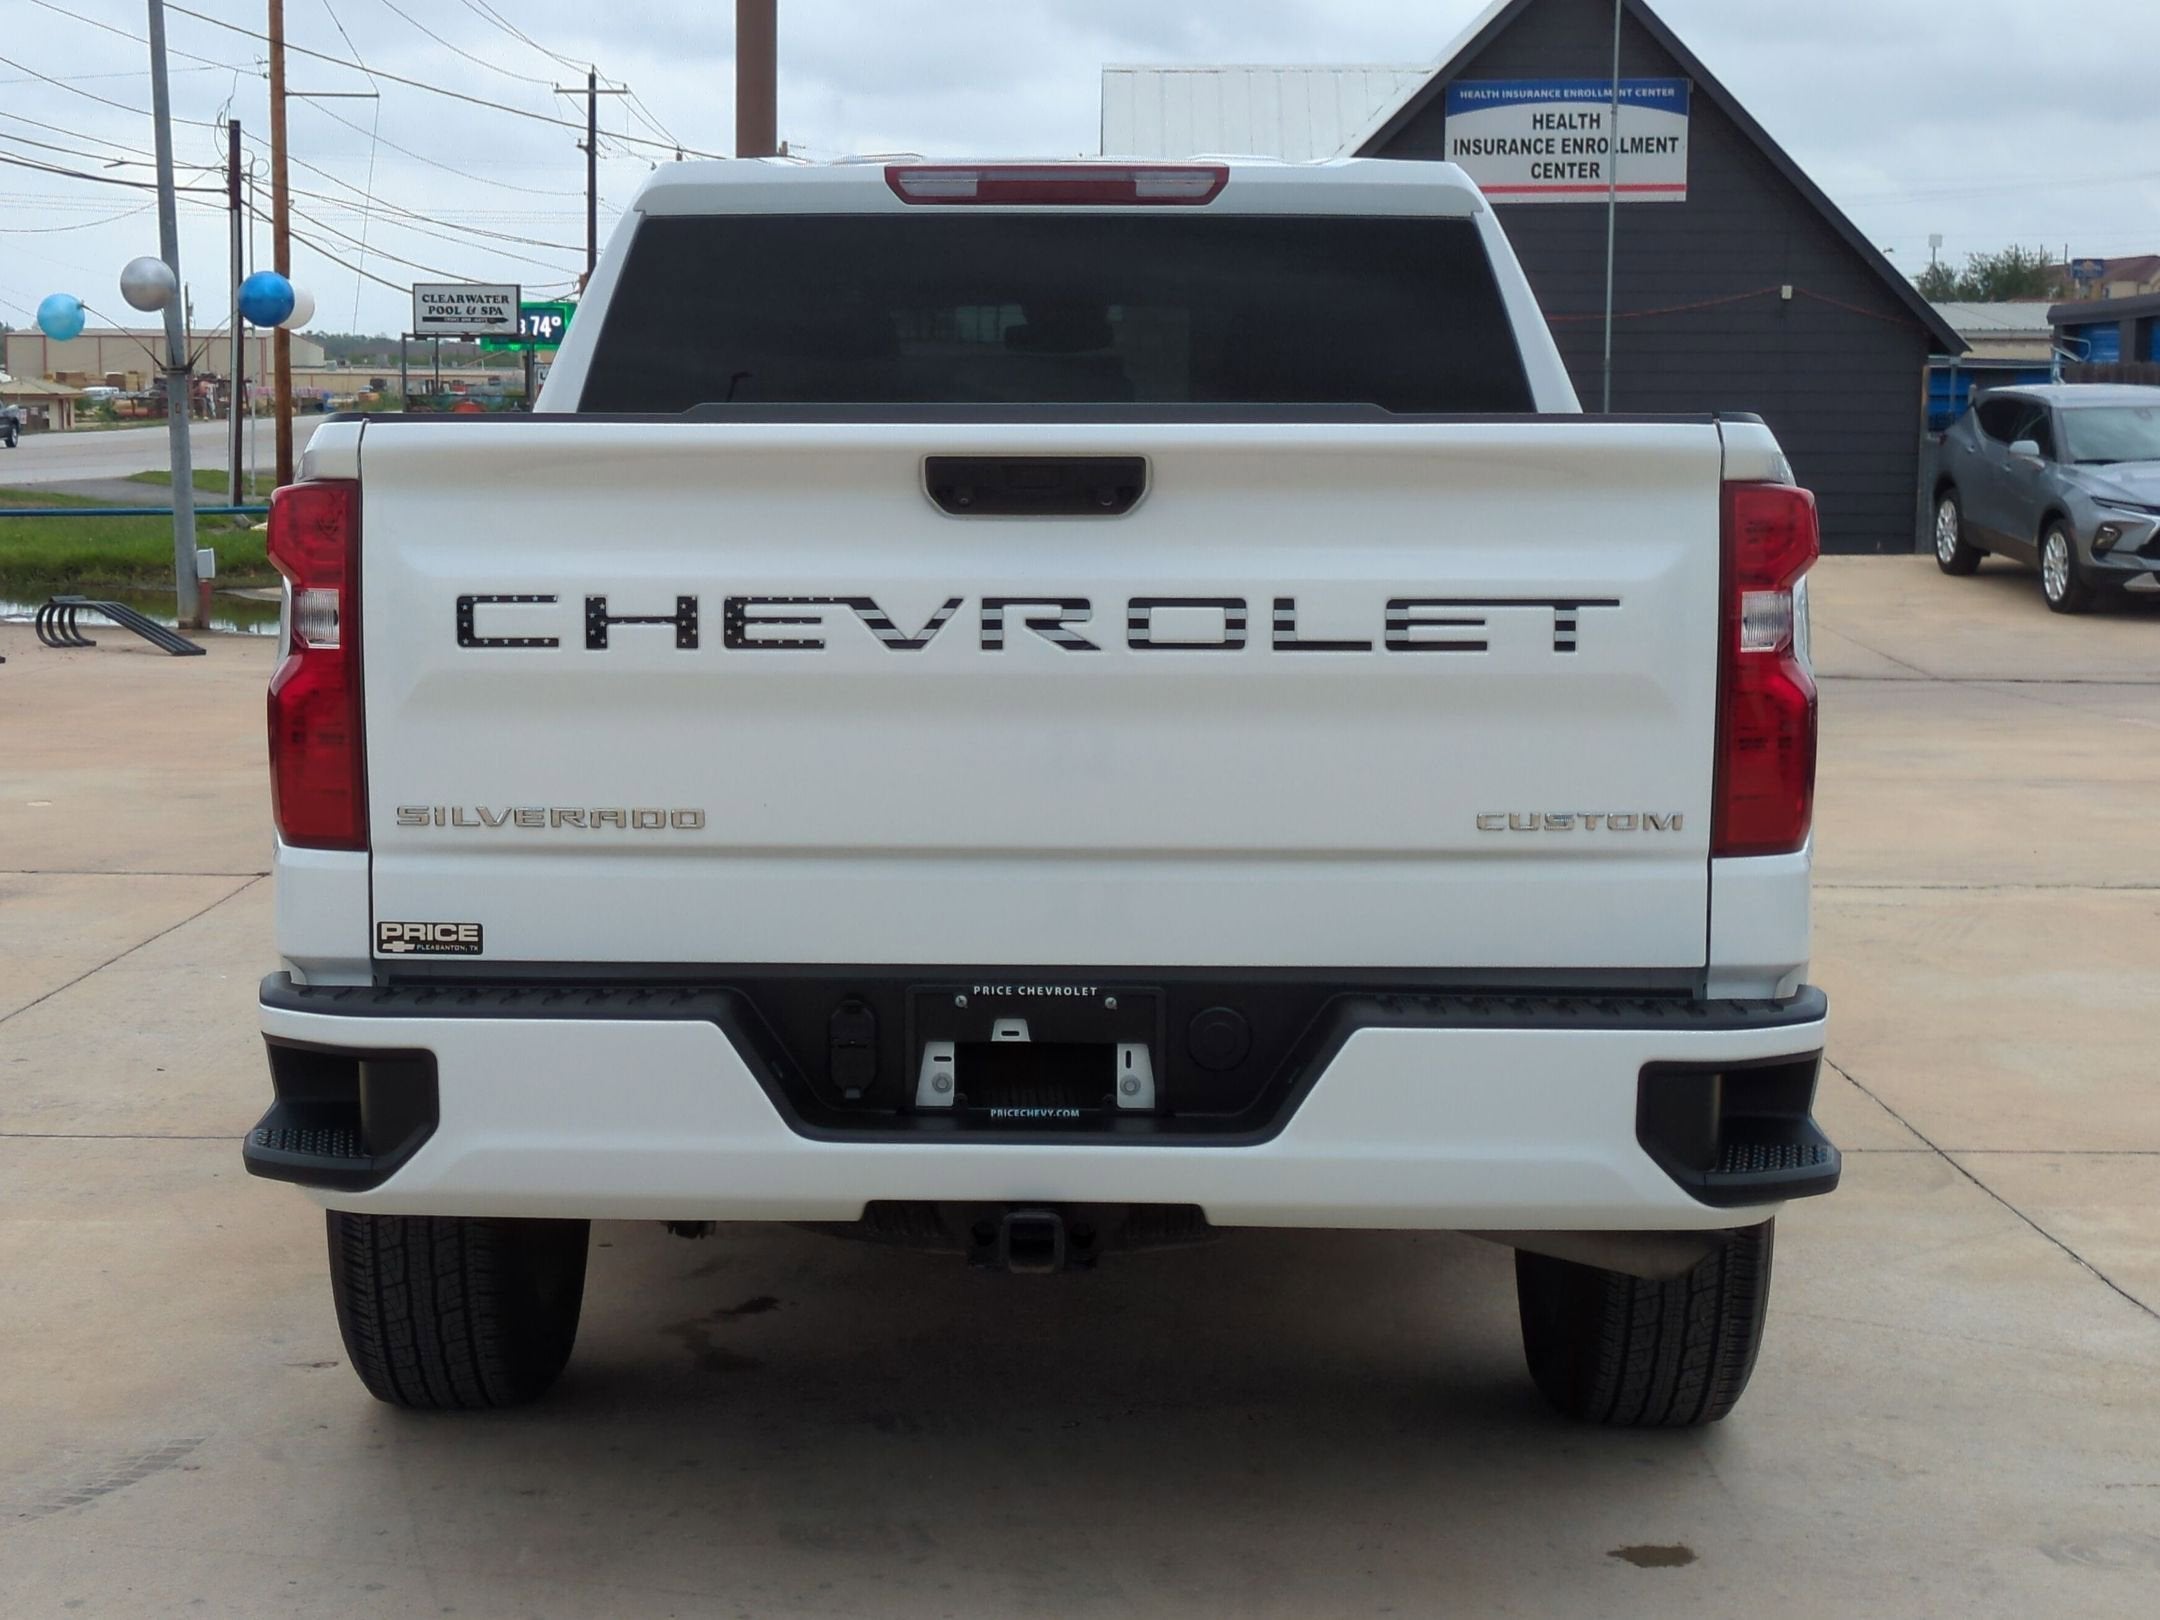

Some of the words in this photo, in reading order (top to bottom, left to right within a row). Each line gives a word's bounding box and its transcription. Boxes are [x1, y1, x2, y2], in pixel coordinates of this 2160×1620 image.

[1460, 89, 1499, 99] HEALTH
[1502, 88, 1561, 99] INSURANCE
[1563, 88, 1632, 98] ENROLLMNT
[1635, 88, 1675, 97] CENTER
[1532, 113, 1600, 130] HEALTH
[1453, 138, 1556, 156] INSURANCE
[1561, 136, 1679, 155] ENROLMENT
[1531, 162, 1600, 179] CENTER
[421, 294, 509, 305] CLEARWATER
[428, 305, 461, 315] POOL
[466, 306, 476, 315] &
[481, 306, 504, 316] SPA
[457, 595, 1620, 652] CHEVROLET
[396, 805, 706, 829] SILVERADO
[1476, 812, 1683, 832] CUSTOM
[381, 923, 479, 942] PRICE
[973, 985, 1012, 996] PRICE
[1018, 986, 1098, 996] CHEVROLET
[990, 1108, 1080, 1118] PRICECHEVY.COM
